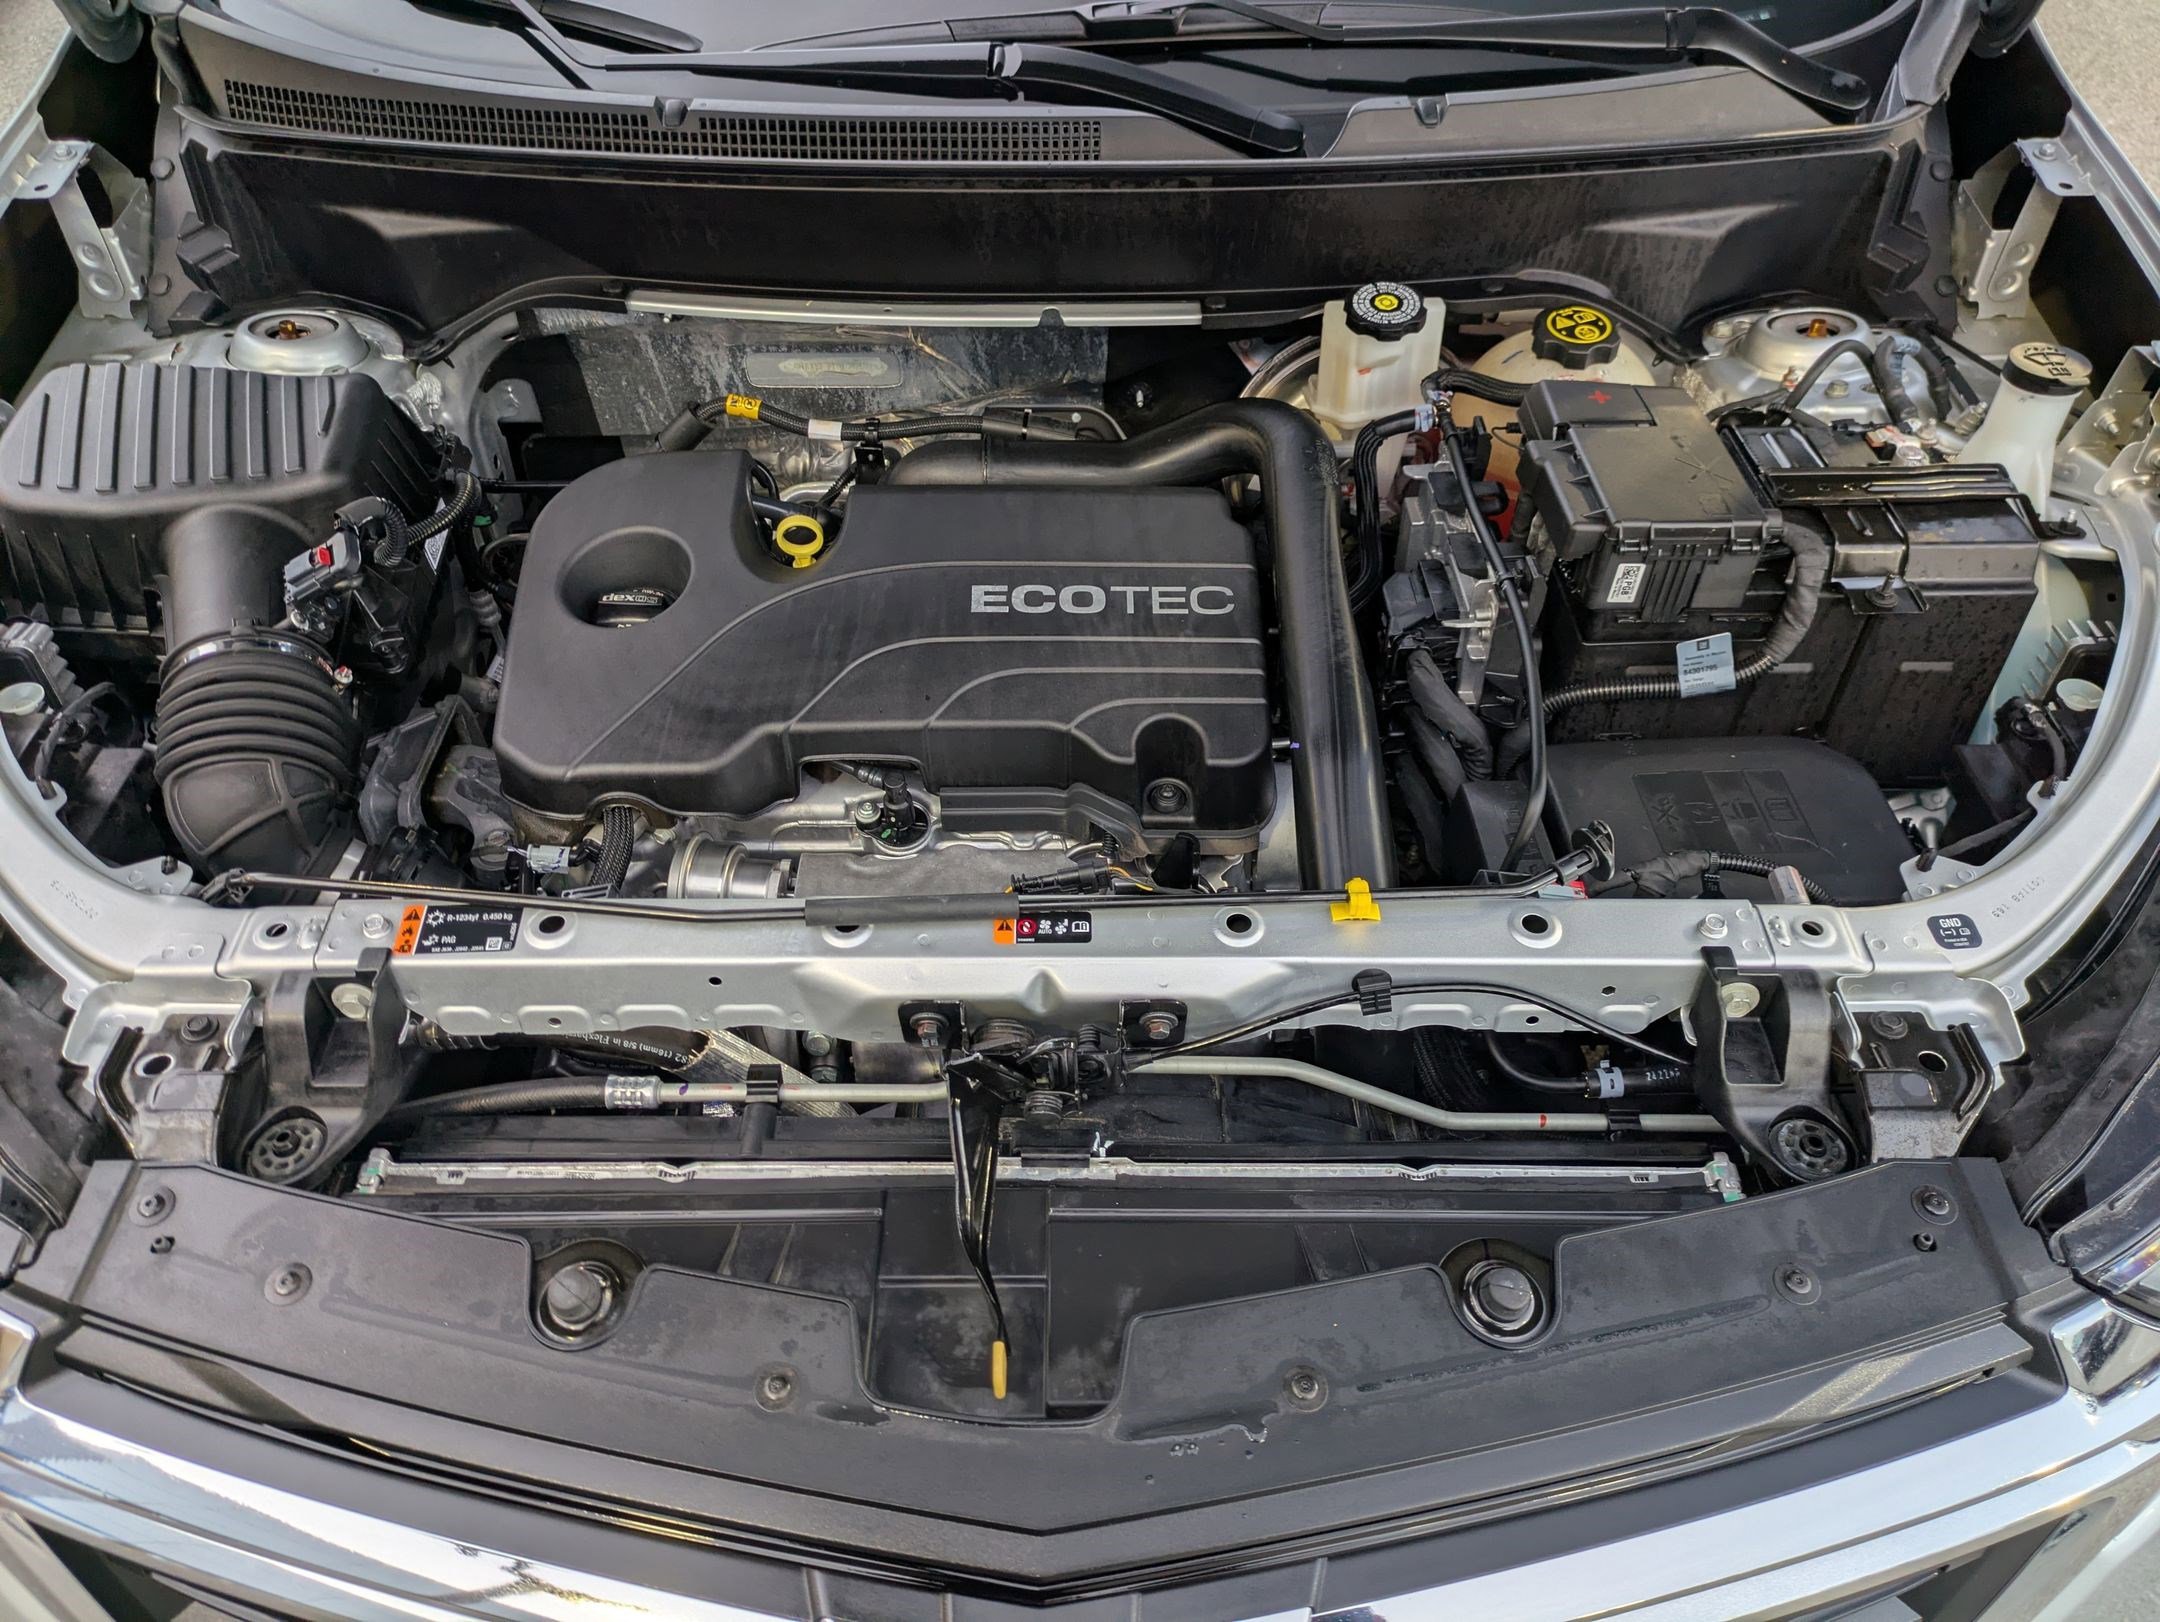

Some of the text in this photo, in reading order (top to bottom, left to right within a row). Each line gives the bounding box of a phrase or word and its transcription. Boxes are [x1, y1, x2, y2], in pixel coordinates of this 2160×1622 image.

[602, 592, 659, 604] dexos
[970, 584, 1235, 615] ECOTEC
[446, 911, 513, 922] R-1234yf 0.450 kg
[1939, 917, 1962, 928] GND
[441, 935, 457, 944] PAG
[613, 1037, 621, 1046] in
[623, 1040, 637, 1050] 5/8
[639, 1042, 673, 1058] (16mm)
